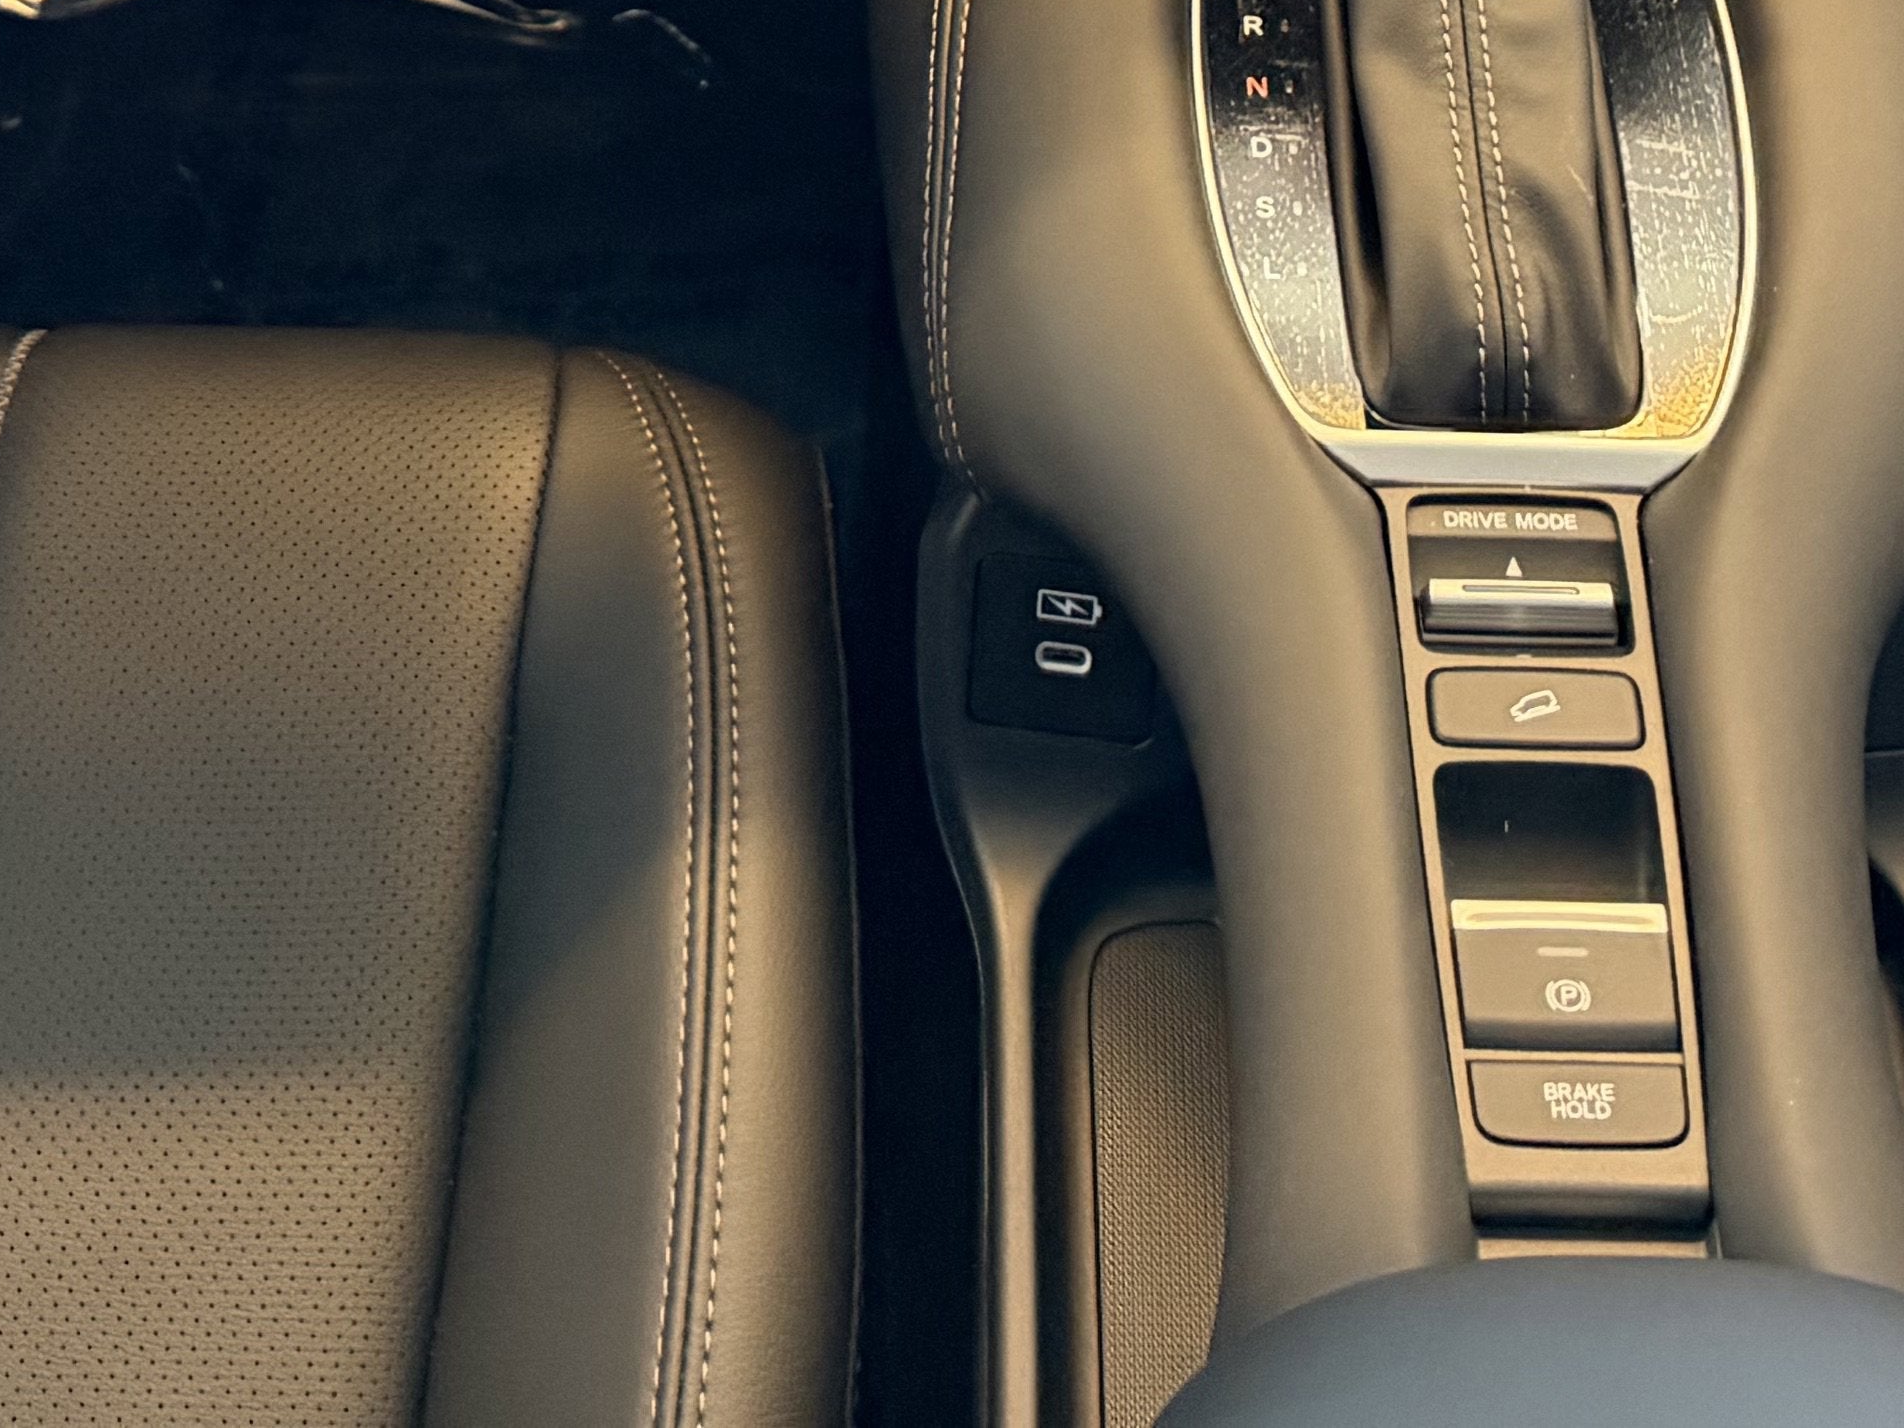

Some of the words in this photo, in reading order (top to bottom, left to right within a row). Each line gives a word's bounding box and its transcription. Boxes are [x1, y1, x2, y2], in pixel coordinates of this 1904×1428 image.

[1243, 15, 1263, 36] R
[1247, 77, 1268, 97] N
[1251, 138, 1272, 157] D
[1255, 197, 1275, 218] S
[1263, 257, 1280, 279] L
[1443, 511, 1507, 529] DRIVE
[1515, 513, 1578, 530] MODE
[1543, 1082, 1615, 1101] BRAKE
[1550, 1100, 1611, 1119] HOLD
